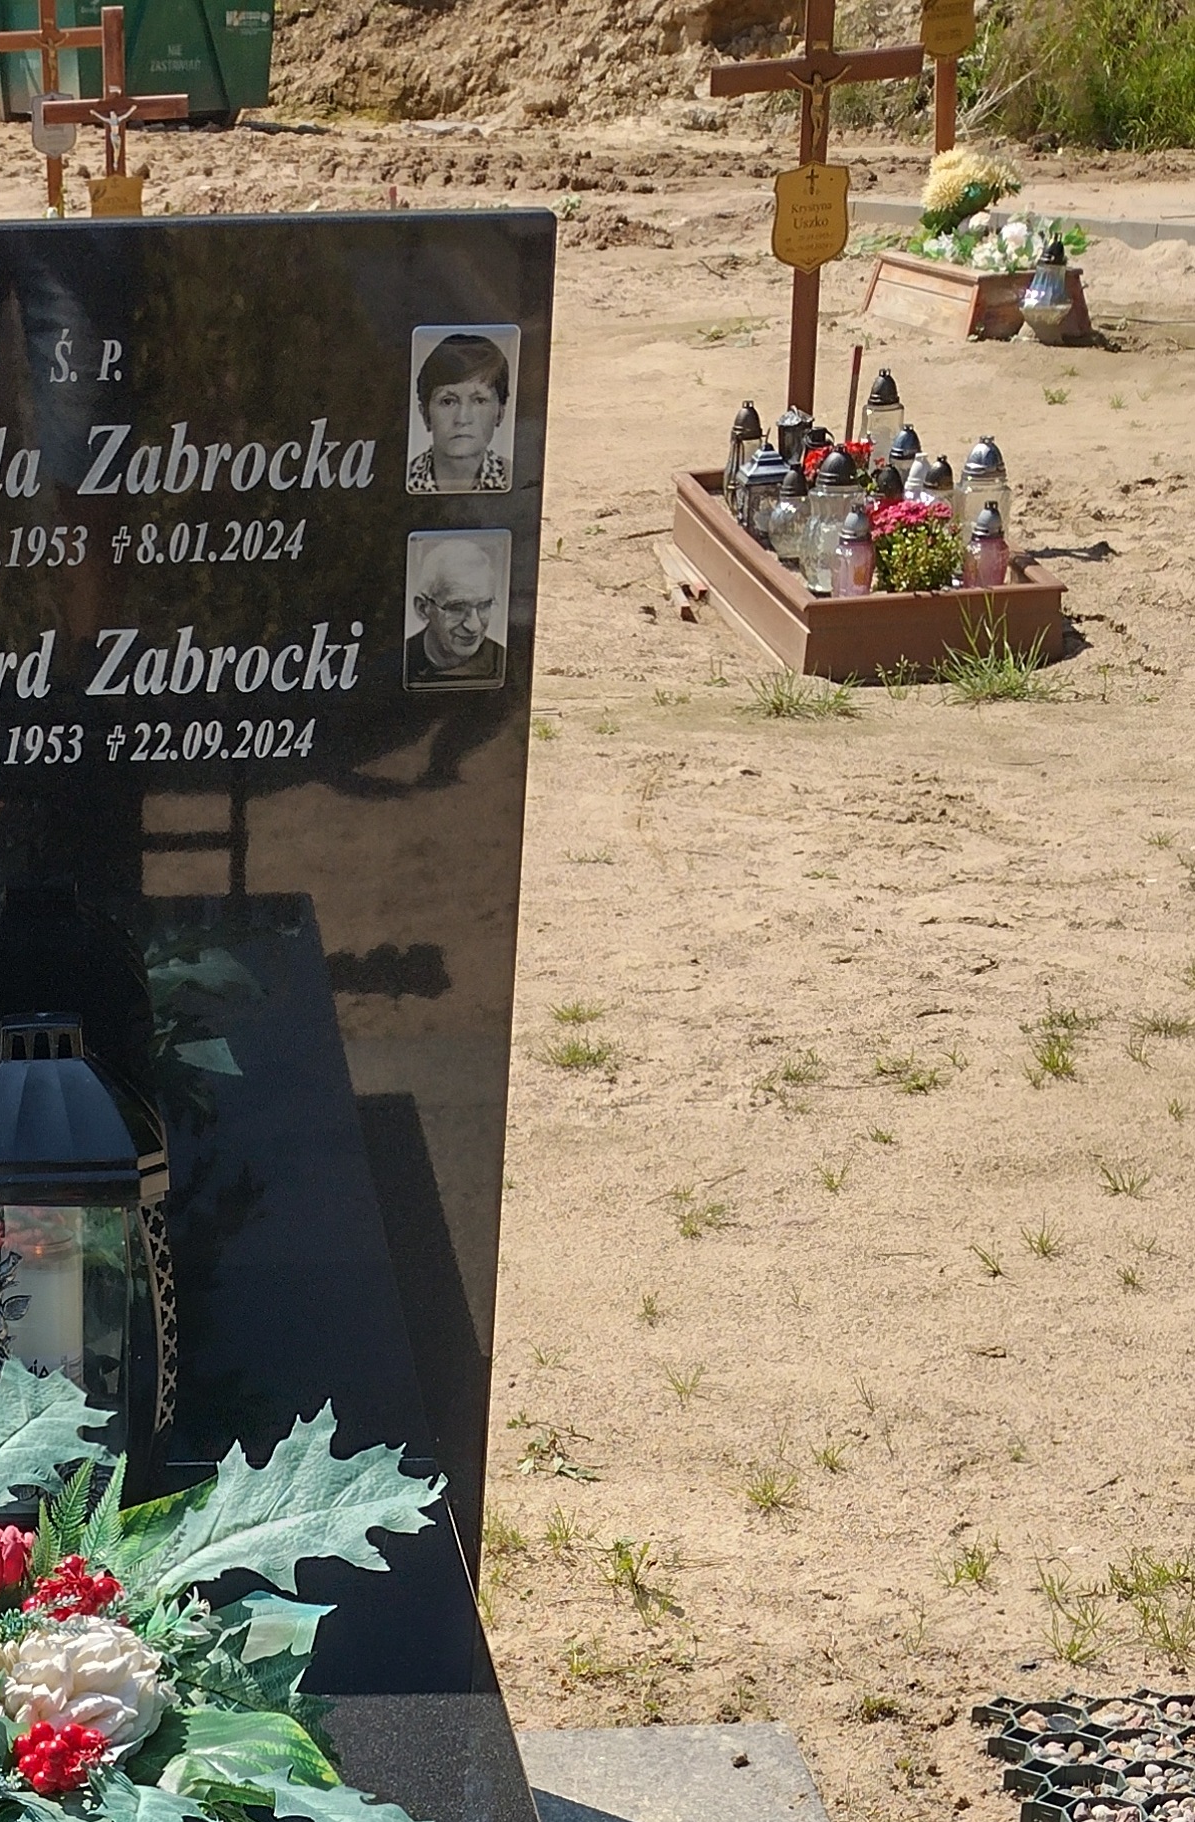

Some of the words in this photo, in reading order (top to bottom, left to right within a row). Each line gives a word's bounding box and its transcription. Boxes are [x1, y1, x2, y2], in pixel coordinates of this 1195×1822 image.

[793, 216, 829, 230] Uszko
[49, 328, 78, 383] Ś.
[96, 339, 123, 382] P.
[77, 418, 375, 496] Zabrocka
[86, 621, 363, 697] Zabrocki
